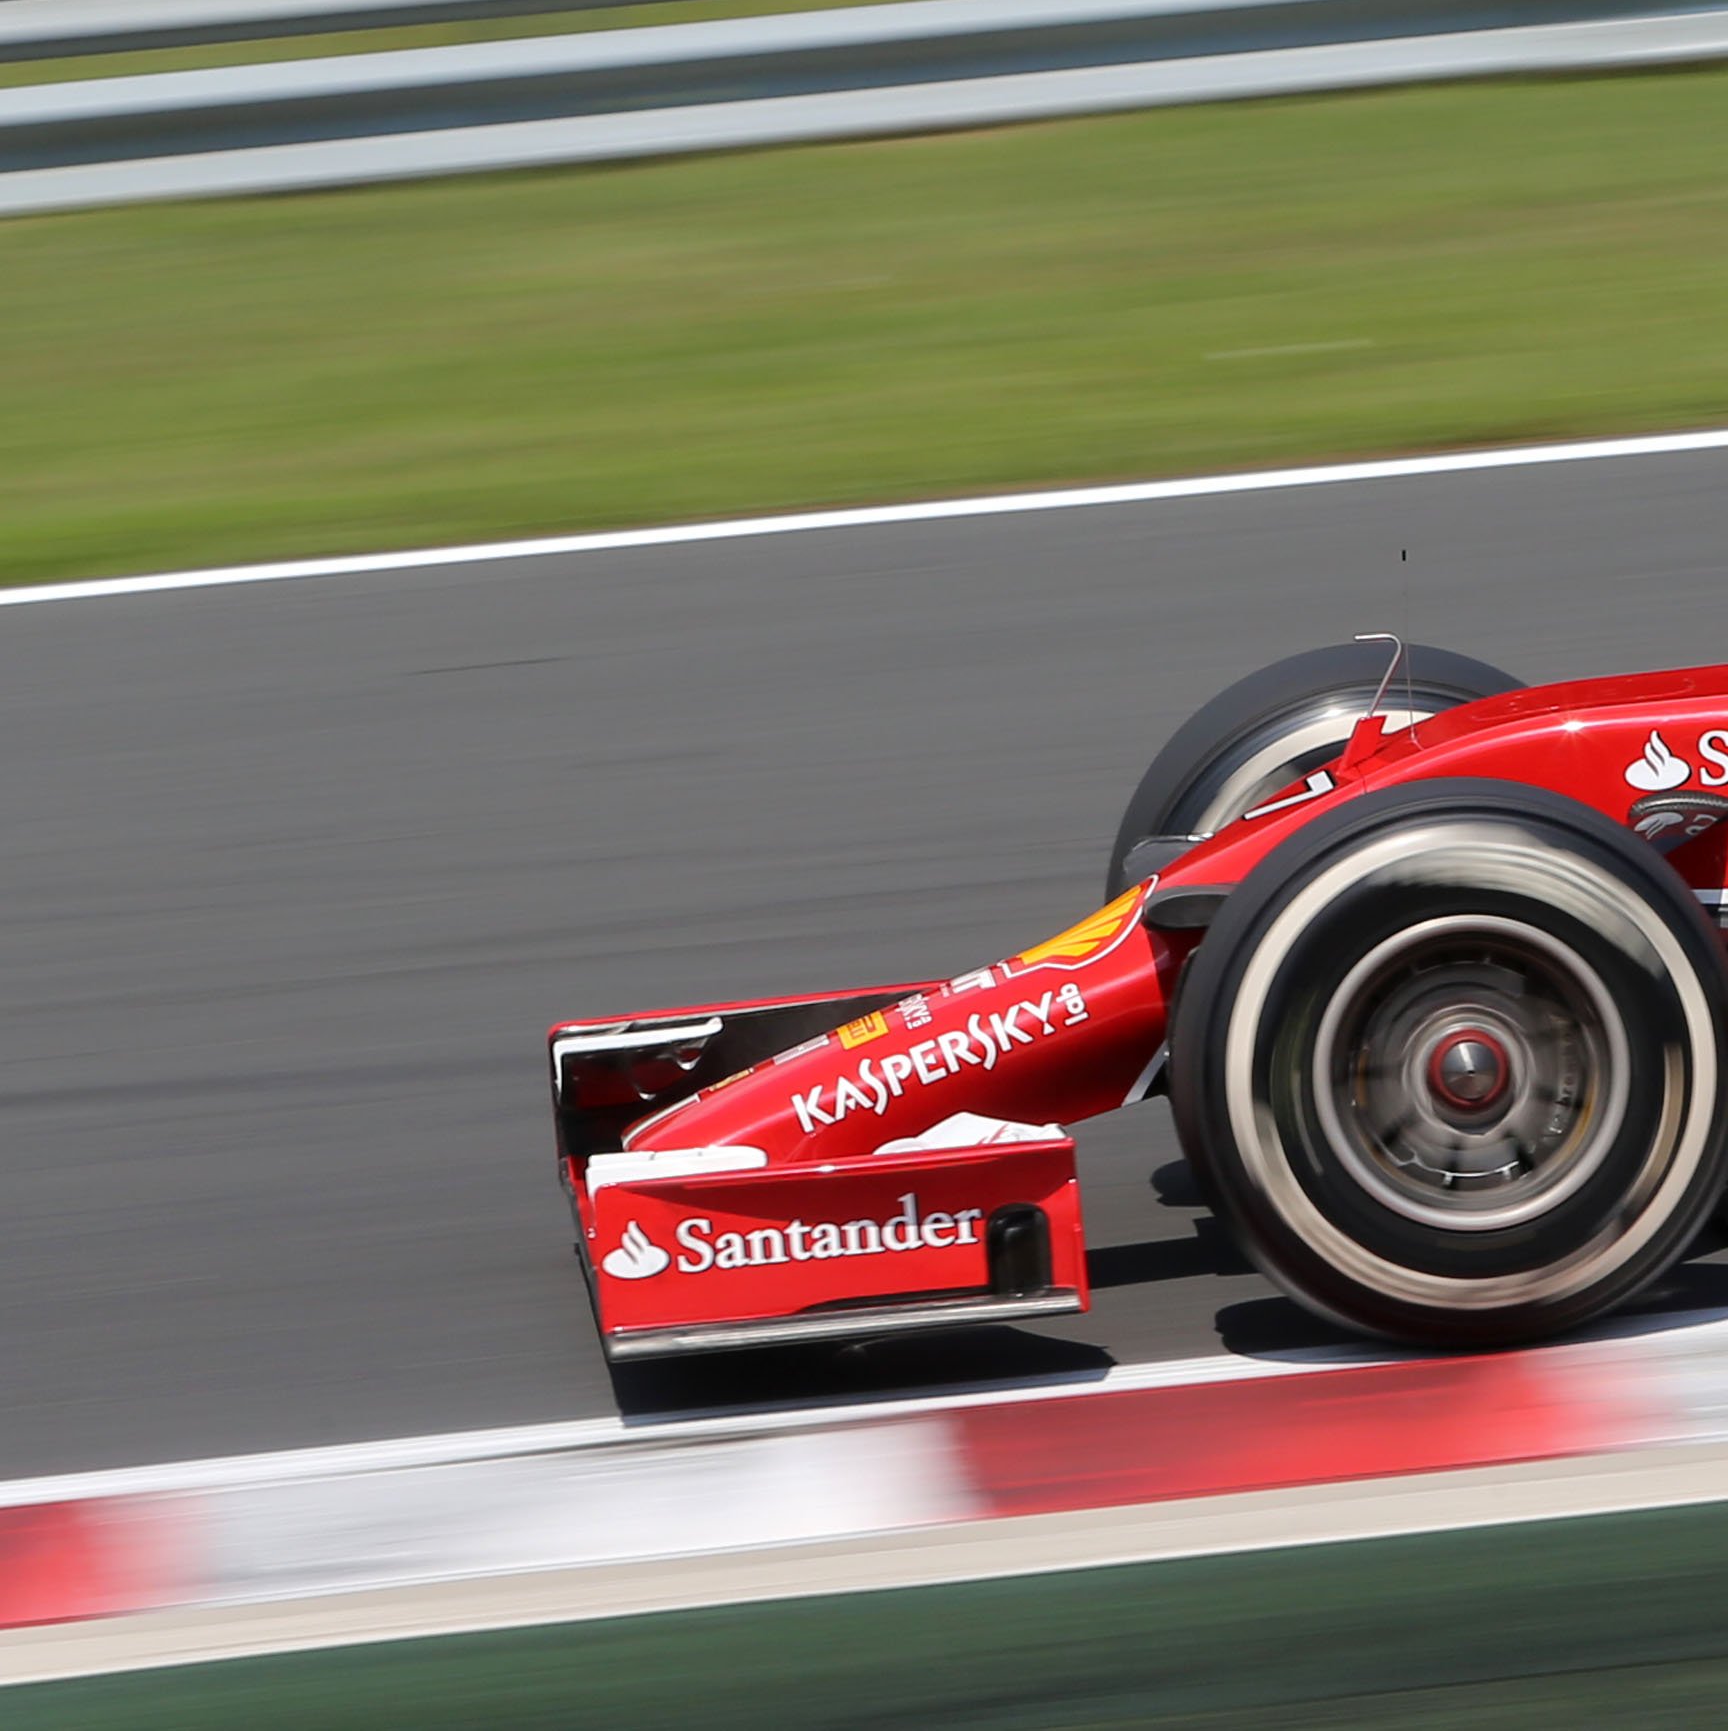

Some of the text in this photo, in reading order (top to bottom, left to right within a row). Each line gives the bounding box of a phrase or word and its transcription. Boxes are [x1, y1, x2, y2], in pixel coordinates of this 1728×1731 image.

[790, 982, 1090, 1134] KASPERSKY lab
[676, 1192, 985, 1275] Santander
